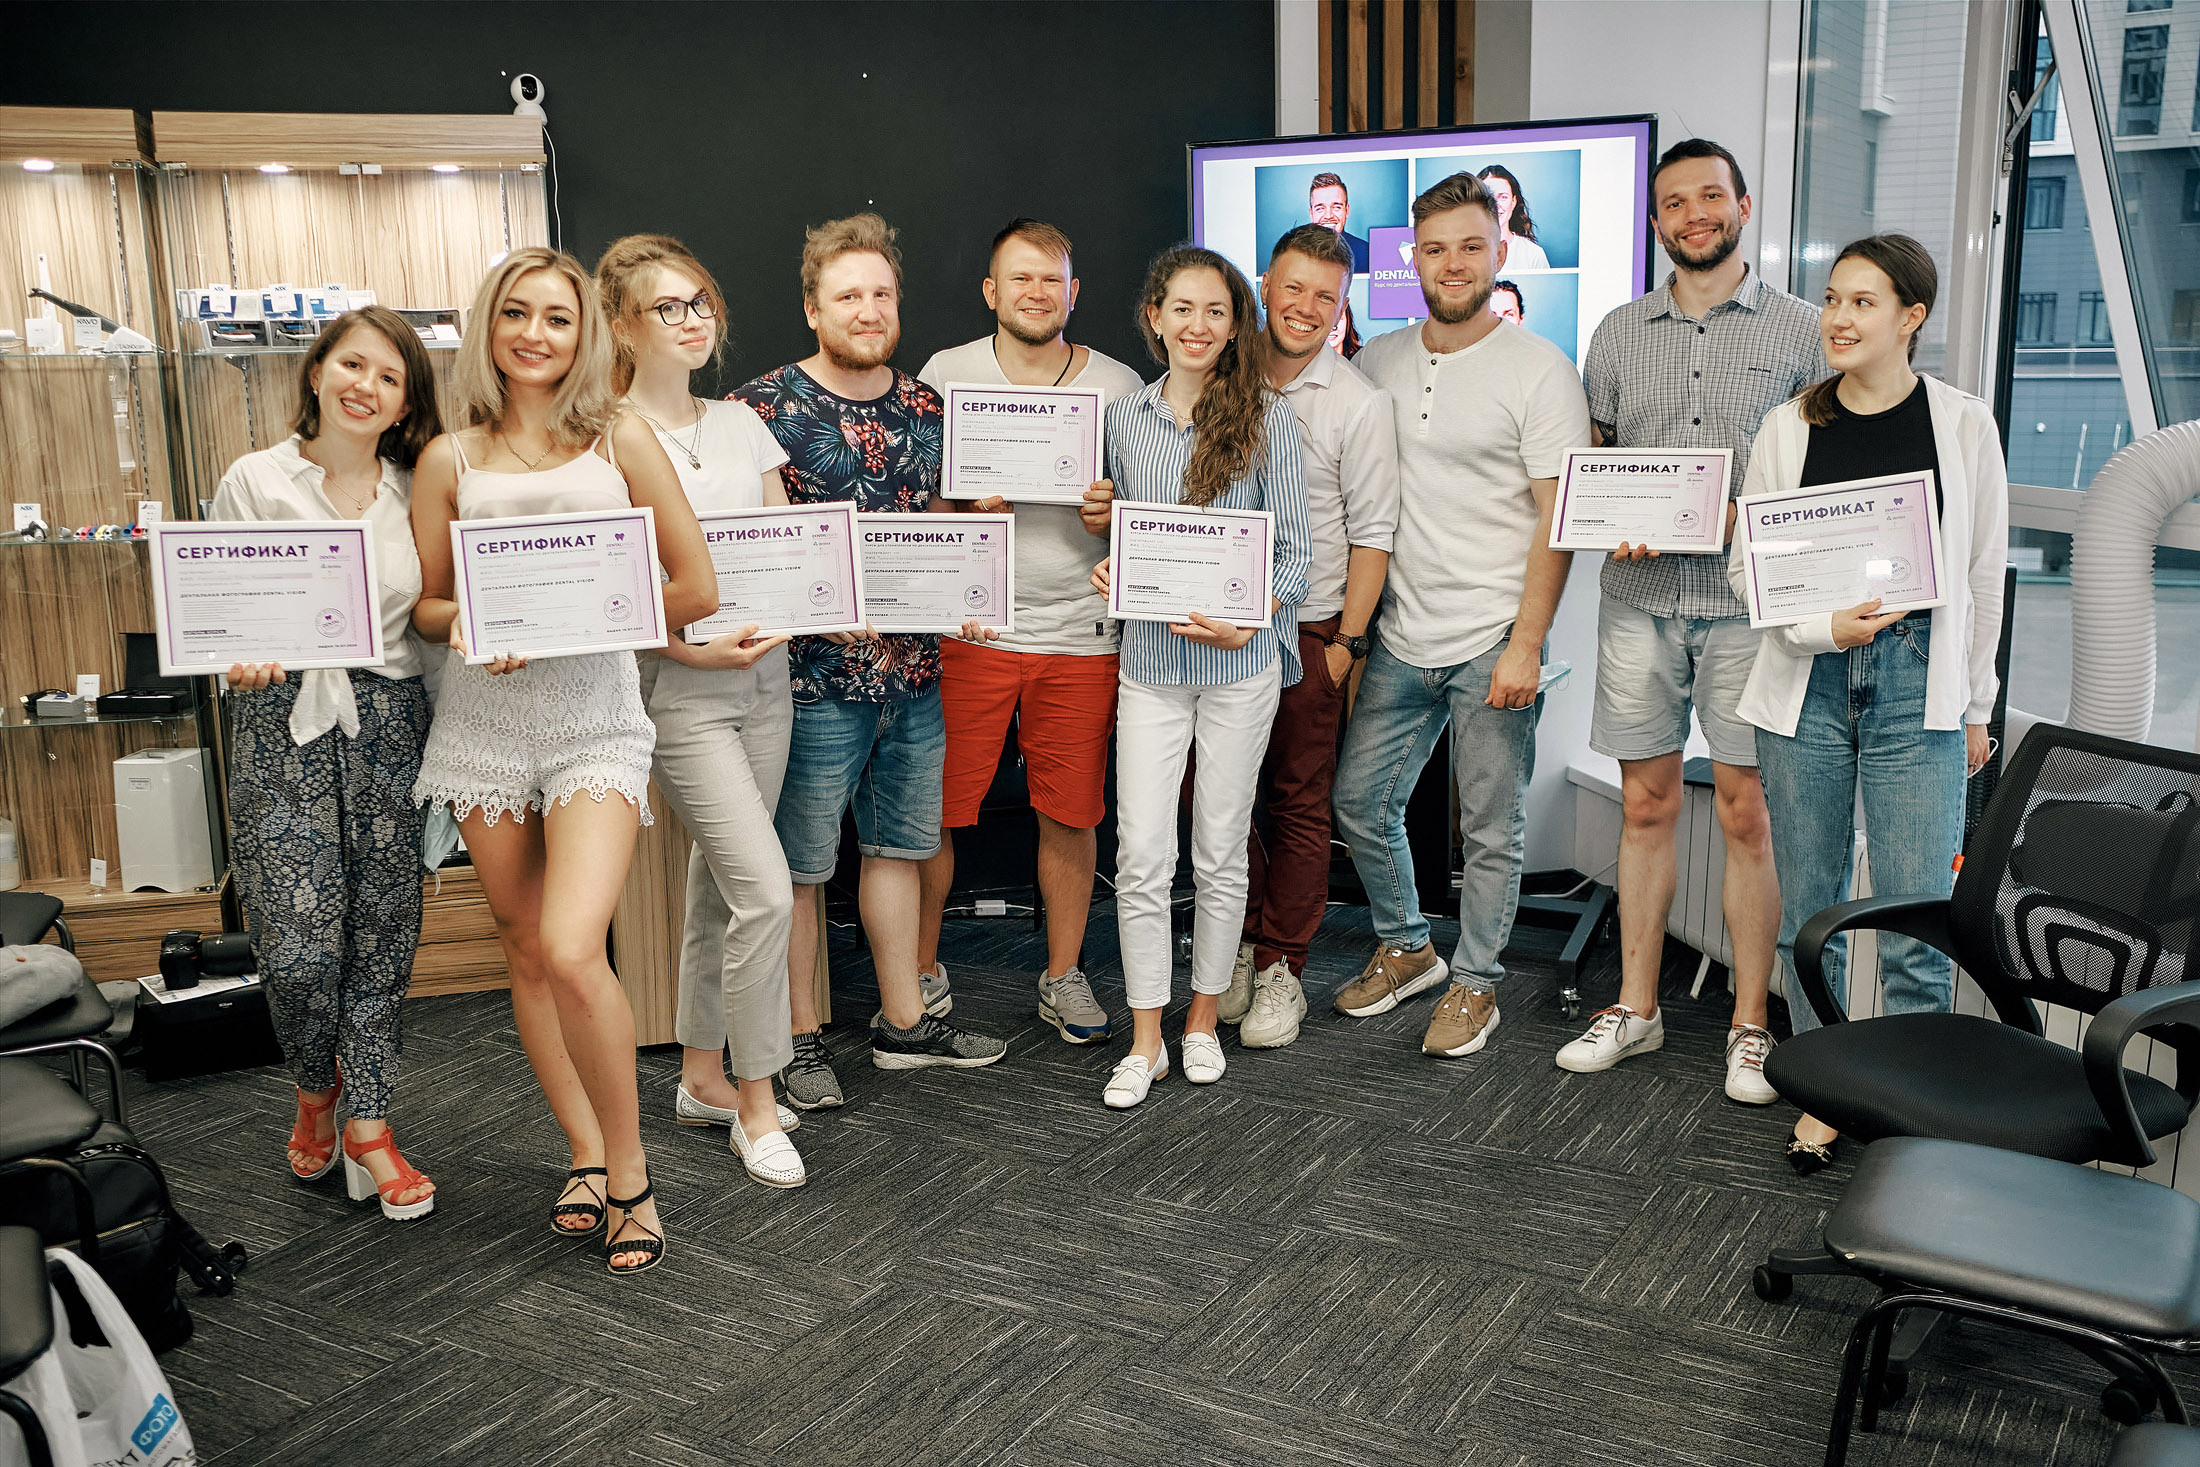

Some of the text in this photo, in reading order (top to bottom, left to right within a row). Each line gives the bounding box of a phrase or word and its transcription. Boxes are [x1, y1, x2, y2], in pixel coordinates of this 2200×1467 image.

[1374, 270, 1416, 280] DENTAL
[962, 402, 1057, 415] СЕРТИФИКАТ
[1580, 465, 1681, 473] СЕРТИФИКАТ
[1760, 501, 1876, 526] СЕРТИФИКАТ
[704, 526, 804, 544] ЕРТИФИКАТ
[1130, 520, 1226, 536] СЕРТИФИКАТ
[477, 535, 597, 555] СЕРТИФИКАТ
[865, 533, 965, 543] СЕРТИФИКАТ
[177, 546, 310, 560] СЕРТИФИКАТ
[140, 1404, 174, 1446] ФОТО
